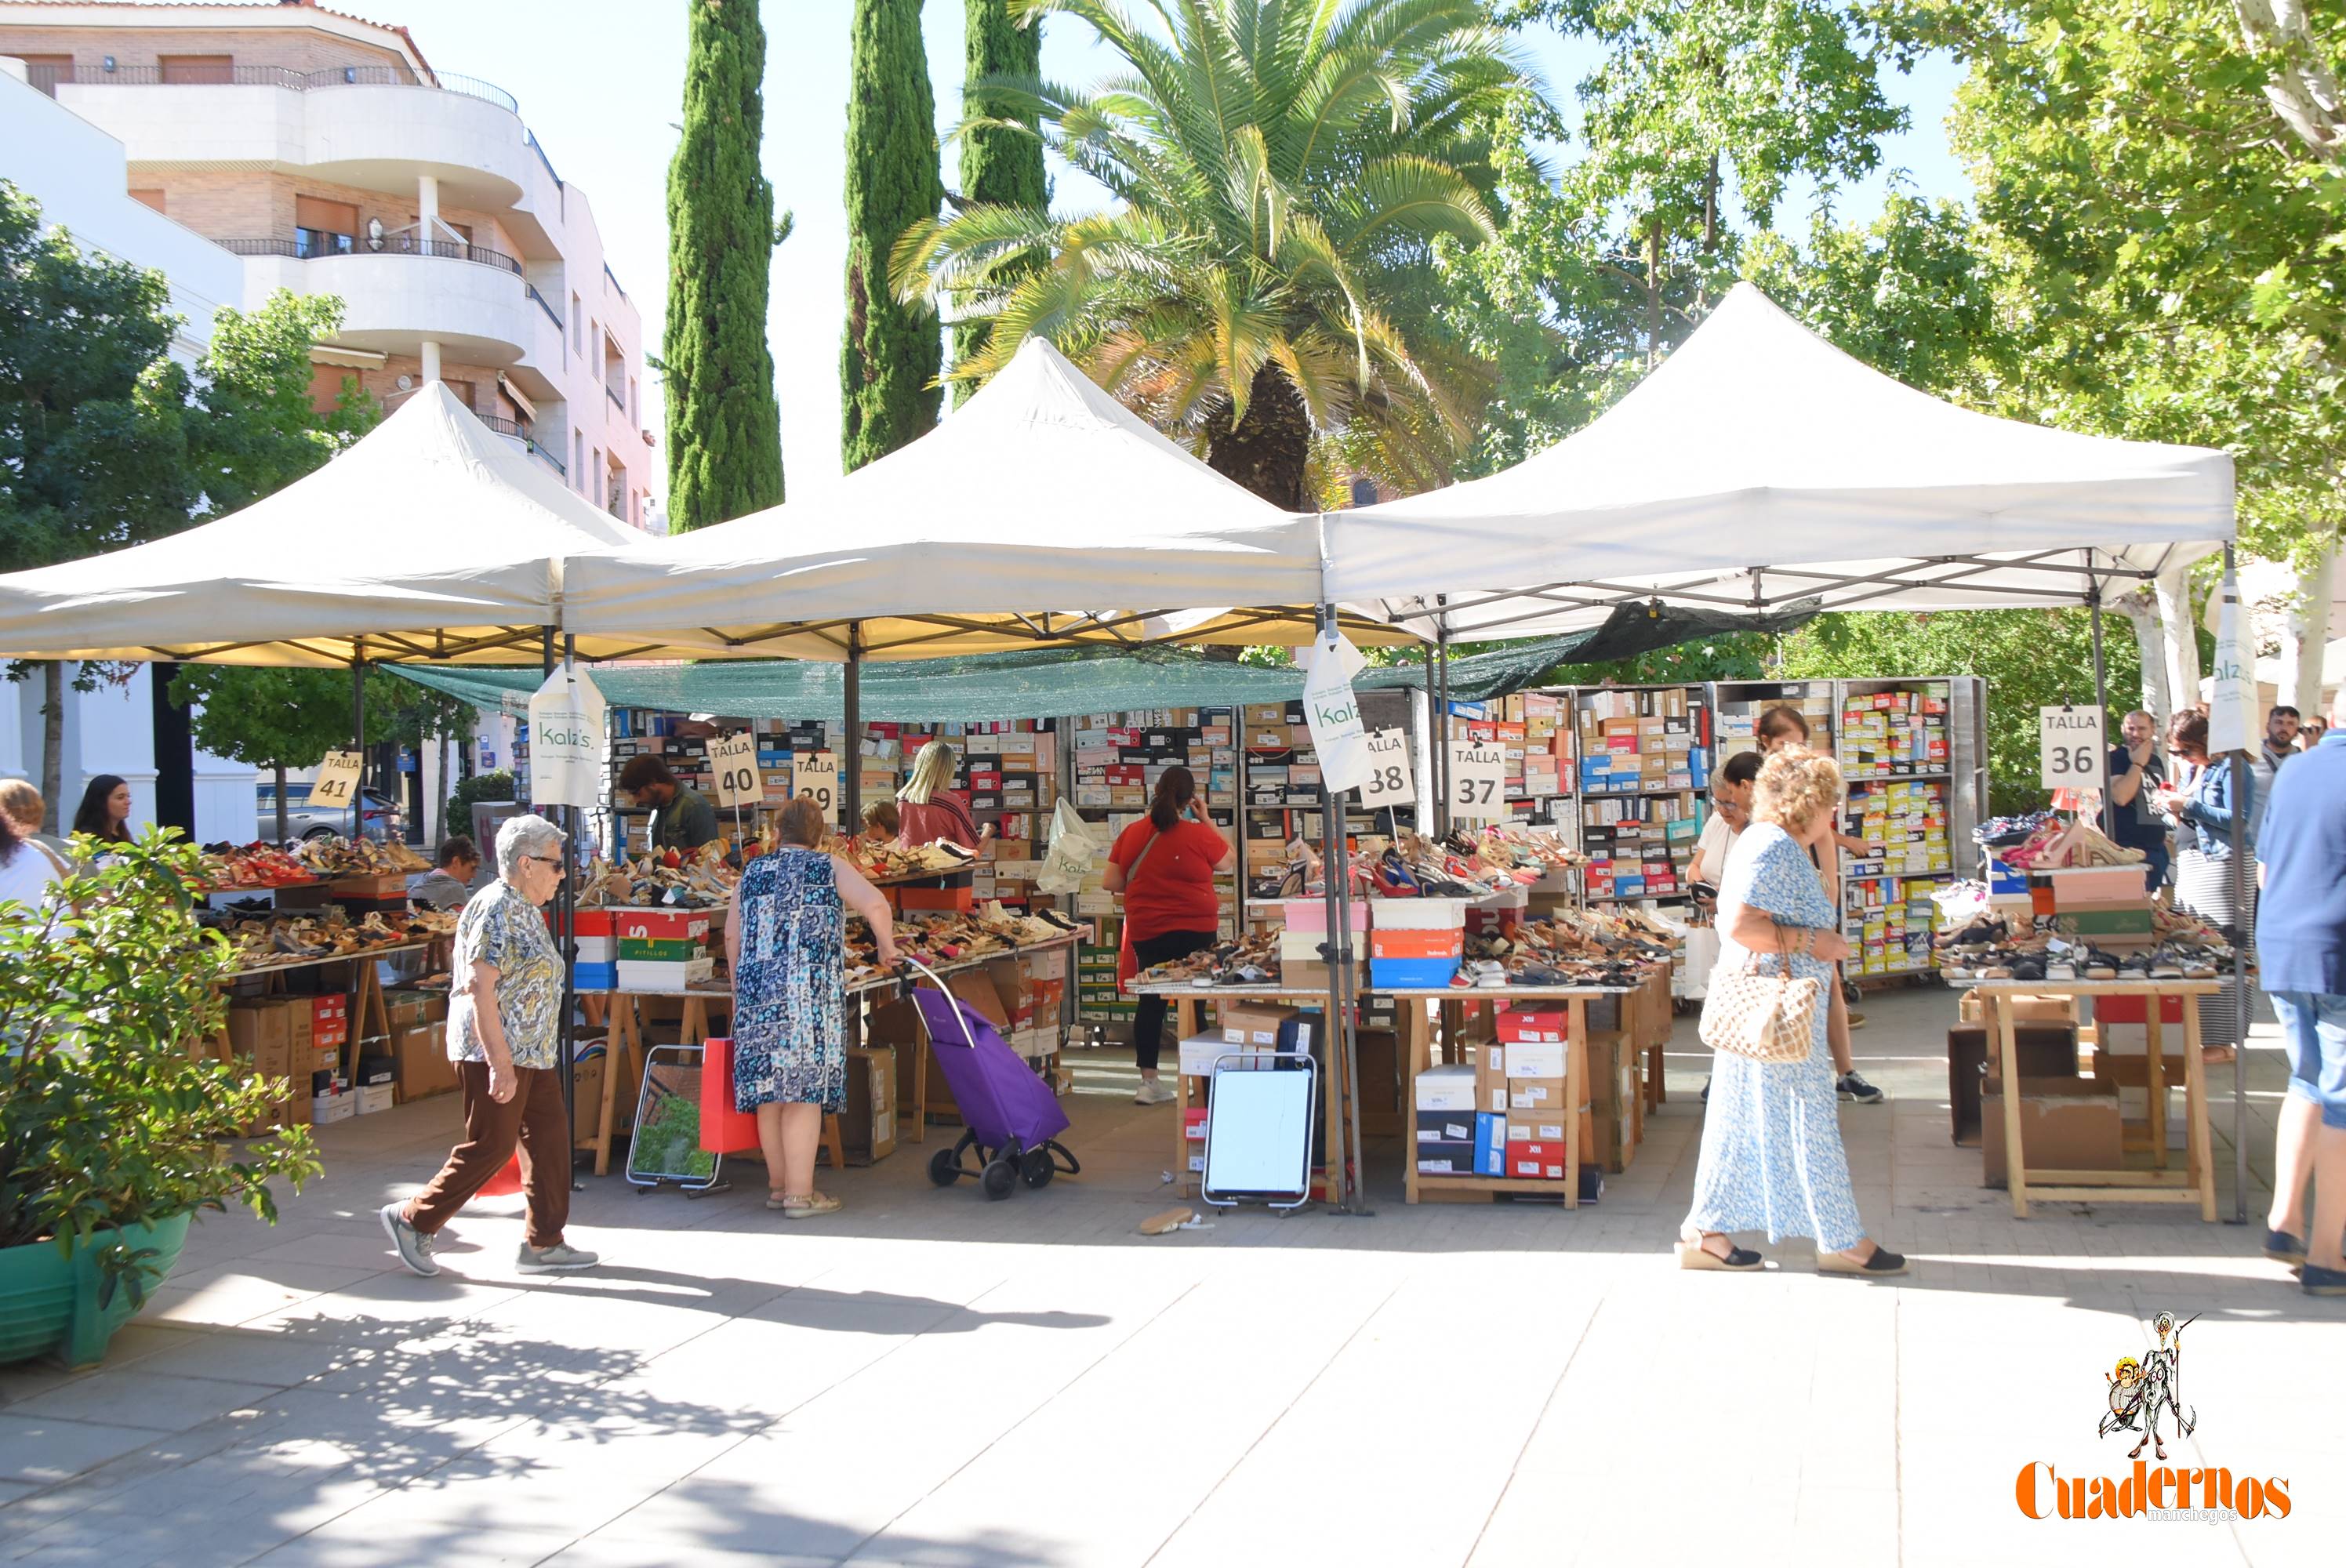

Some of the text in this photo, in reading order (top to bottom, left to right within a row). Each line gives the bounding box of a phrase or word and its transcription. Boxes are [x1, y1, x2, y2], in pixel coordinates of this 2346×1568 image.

[2045, 715, 2097, 729] TALLA
[711, 742, 751, 759] TALLA
[1367, 737, 1402, 753] ALLA
[328, 758, 360, 770] TALLA
[1455, 750, 1501, 764] TALLA
[2051, 746, 2093, 774] 36
[796, 760, 835, 773] TALLA
[319, 779, 347, 798] 41
[722, 768, 754, 793] 40
[1458, 779, 1495, 804] 37
